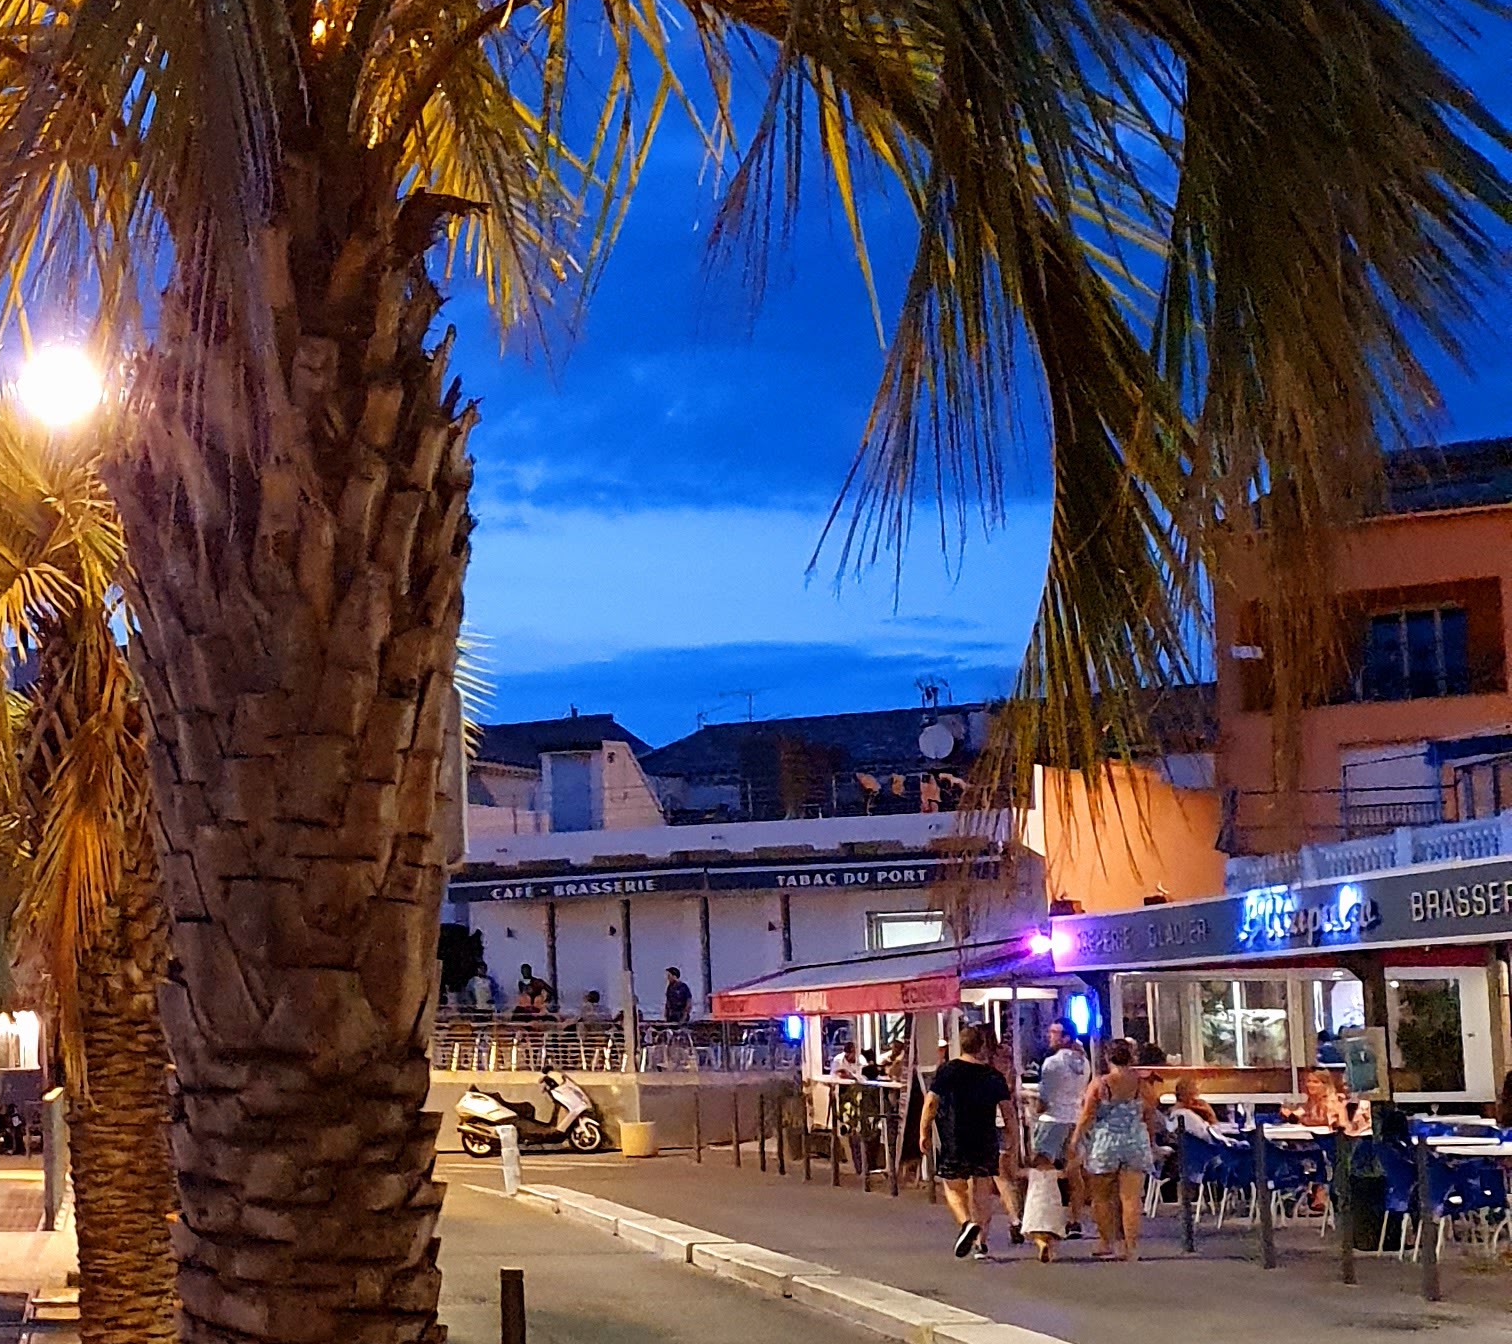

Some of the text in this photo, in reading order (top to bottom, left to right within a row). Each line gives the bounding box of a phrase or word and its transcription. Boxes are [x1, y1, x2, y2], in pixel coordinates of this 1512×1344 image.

[776, 869, 928, 887] TABAC DU PORT
[553, 879, 656, 897] BRASSERIE
